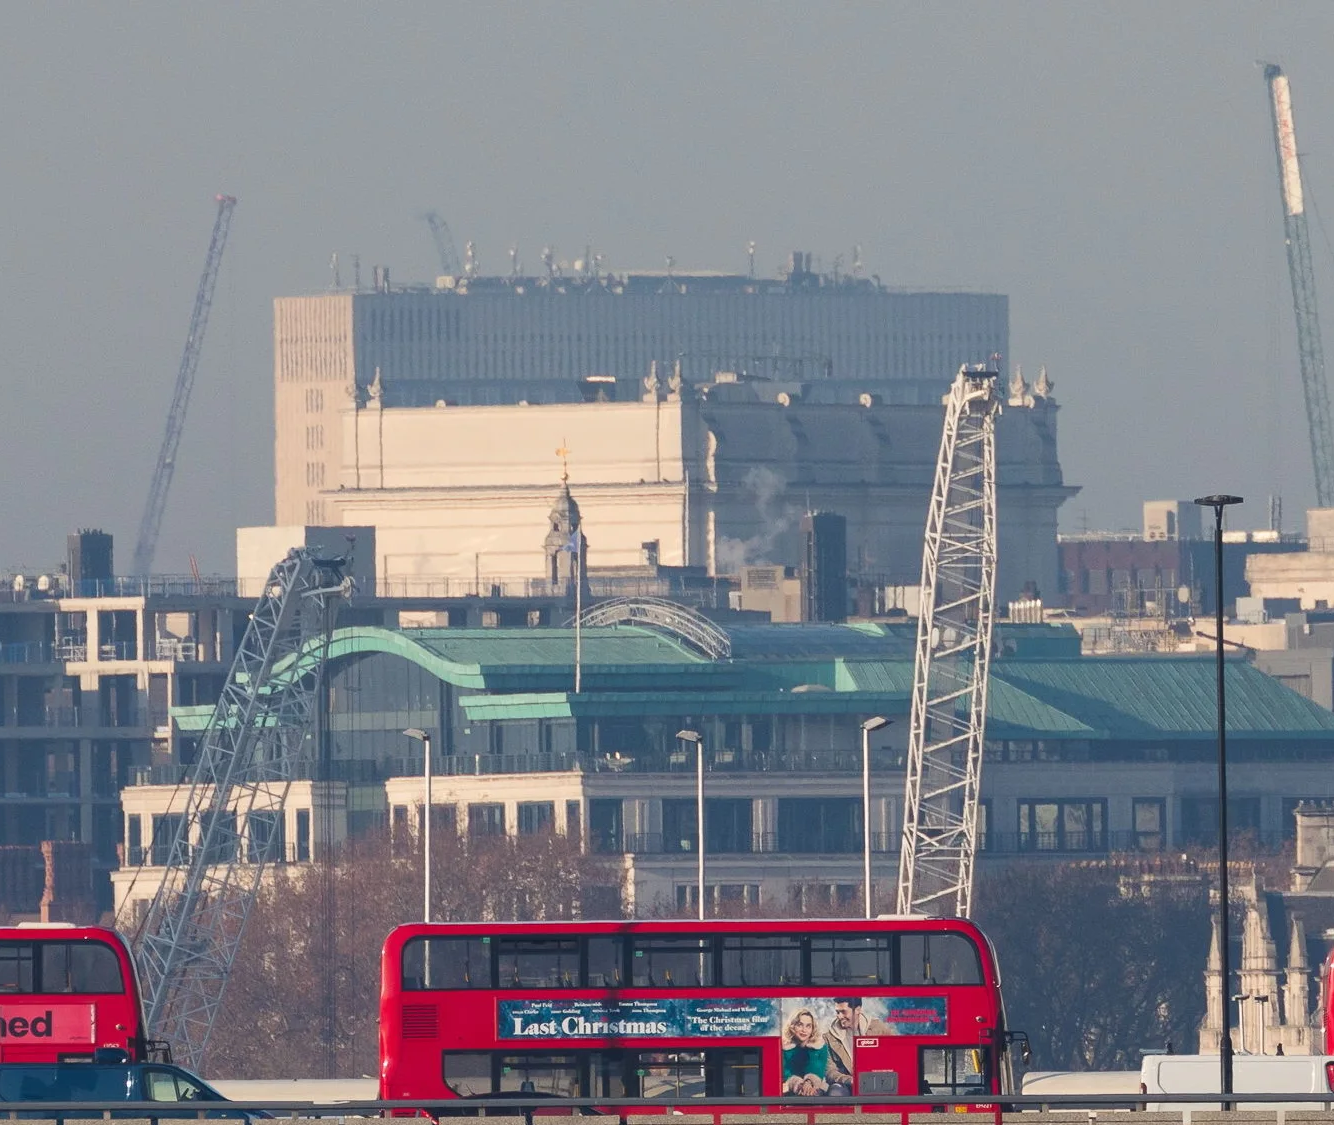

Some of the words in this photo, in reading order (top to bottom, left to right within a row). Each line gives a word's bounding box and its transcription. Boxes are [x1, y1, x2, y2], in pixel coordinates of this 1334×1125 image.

[513, 1017, 557, 1035] Last
[562, 1016, 667, 1035] Christmas
[709, 1016, 750, 1024] Christmas
